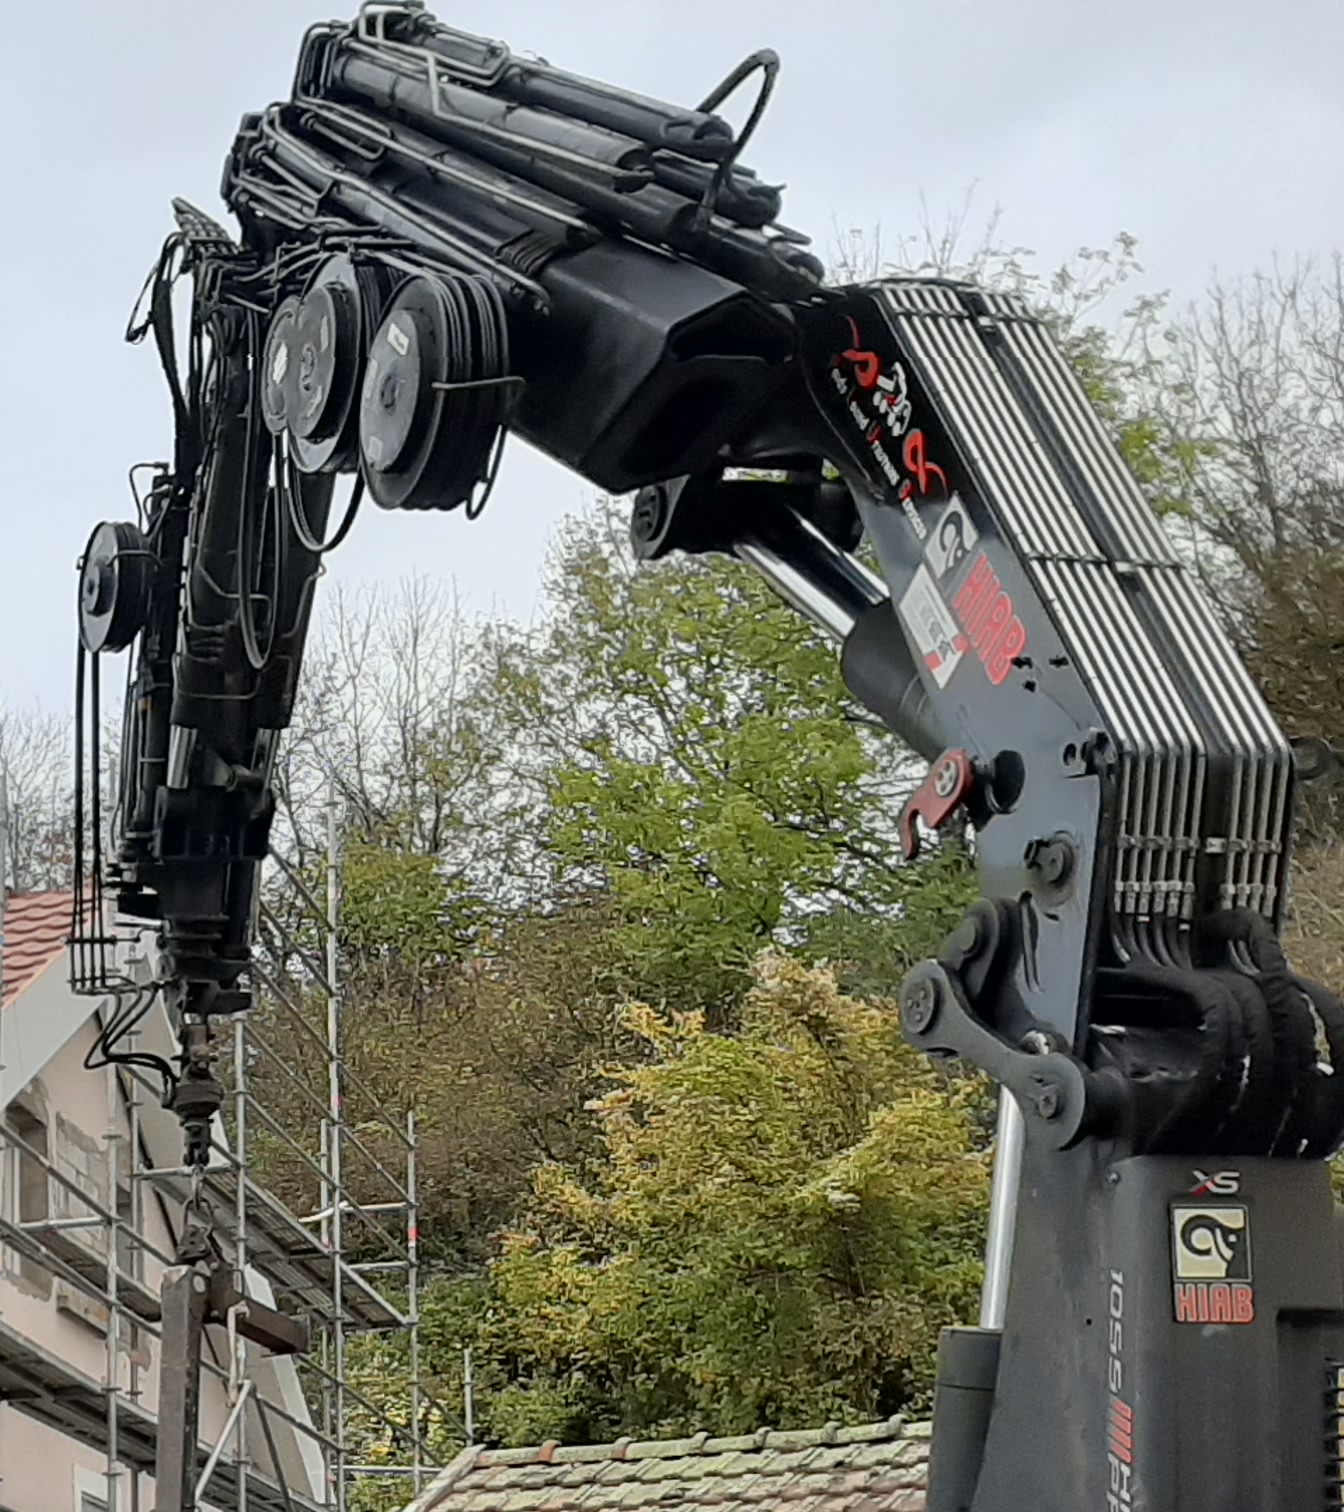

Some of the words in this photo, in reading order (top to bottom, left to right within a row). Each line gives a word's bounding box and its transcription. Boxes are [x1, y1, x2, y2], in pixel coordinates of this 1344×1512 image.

[952, 549, 1027, 686] HIAB
[1188, 1170, 1241, 1197] XS
[1107, 1269, 1124, 1392] 1055
[1173, 1283, 1255, 1324] HIAB
